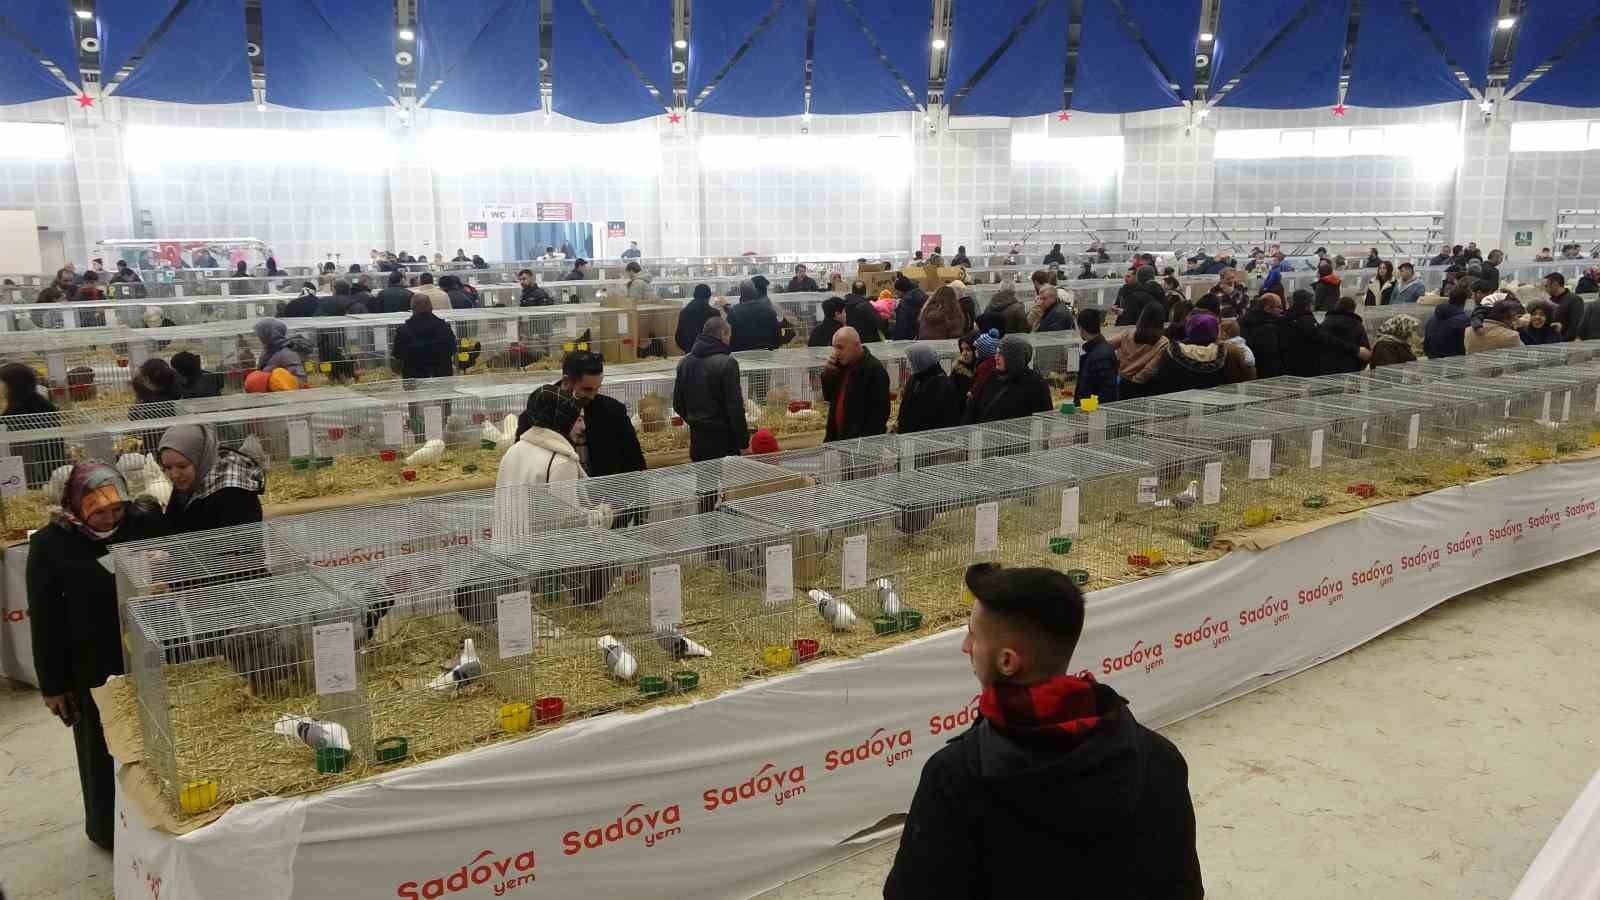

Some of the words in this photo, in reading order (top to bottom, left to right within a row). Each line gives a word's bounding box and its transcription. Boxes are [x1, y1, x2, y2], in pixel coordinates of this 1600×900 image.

[1213, 633, 1230, 648] yem
[1145, 657, 1164, 673] yem
[886, 748, 912, 767] yem
[775, 785, 806, 806] yem
[645, 826, 681, 847] yem
[494, 873, 536, 896] yem
